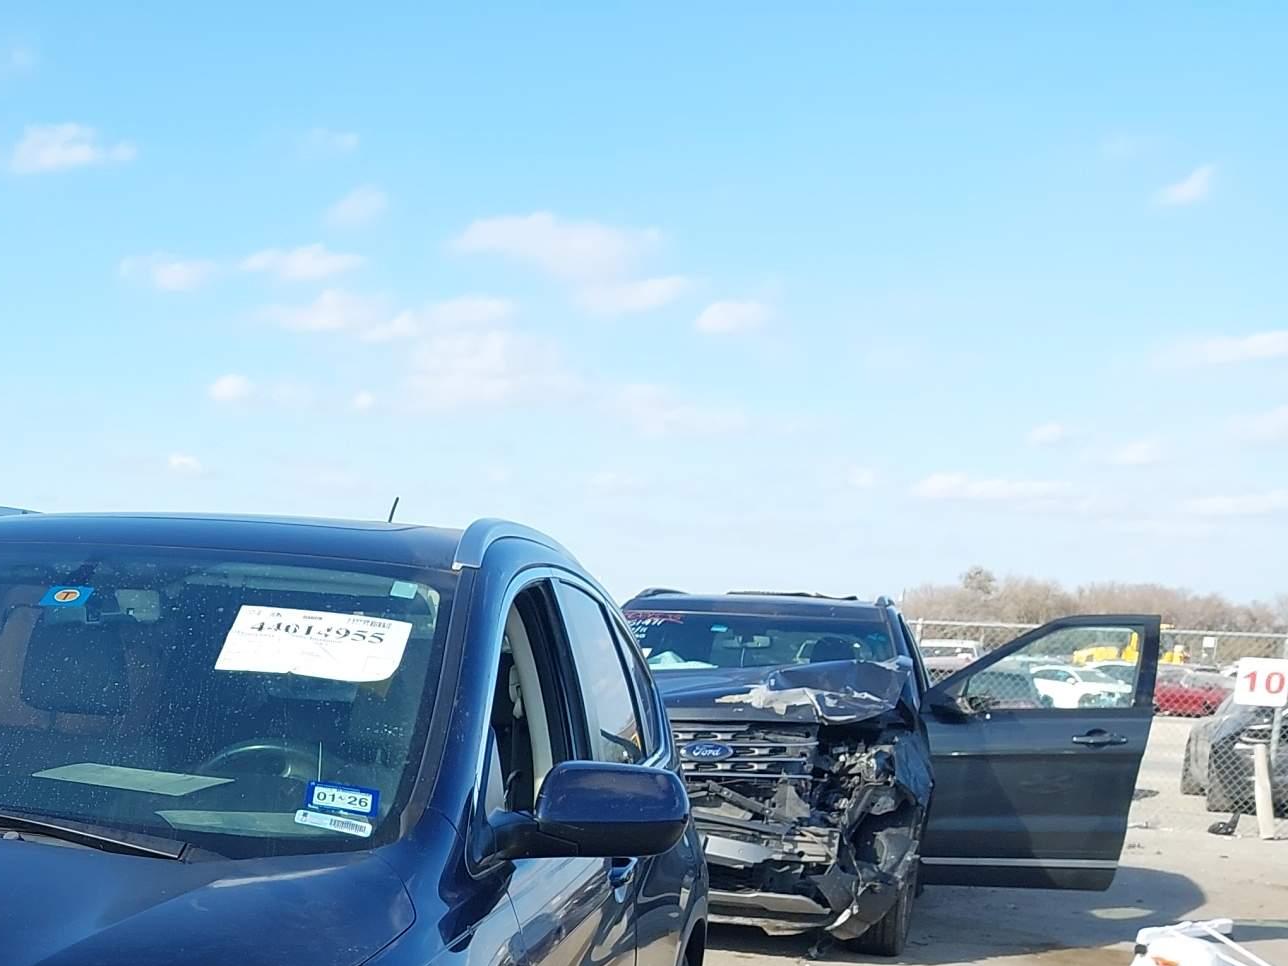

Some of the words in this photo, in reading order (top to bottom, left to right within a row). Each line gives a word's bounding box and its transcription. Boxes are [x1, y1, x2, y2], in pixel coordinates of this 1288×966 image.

[1243, 670, 1286, 694] 10
[692, 746, 721, 757] Ford
[316, 791, 336, 803] 01
[346, 795, 370, 808] 26
